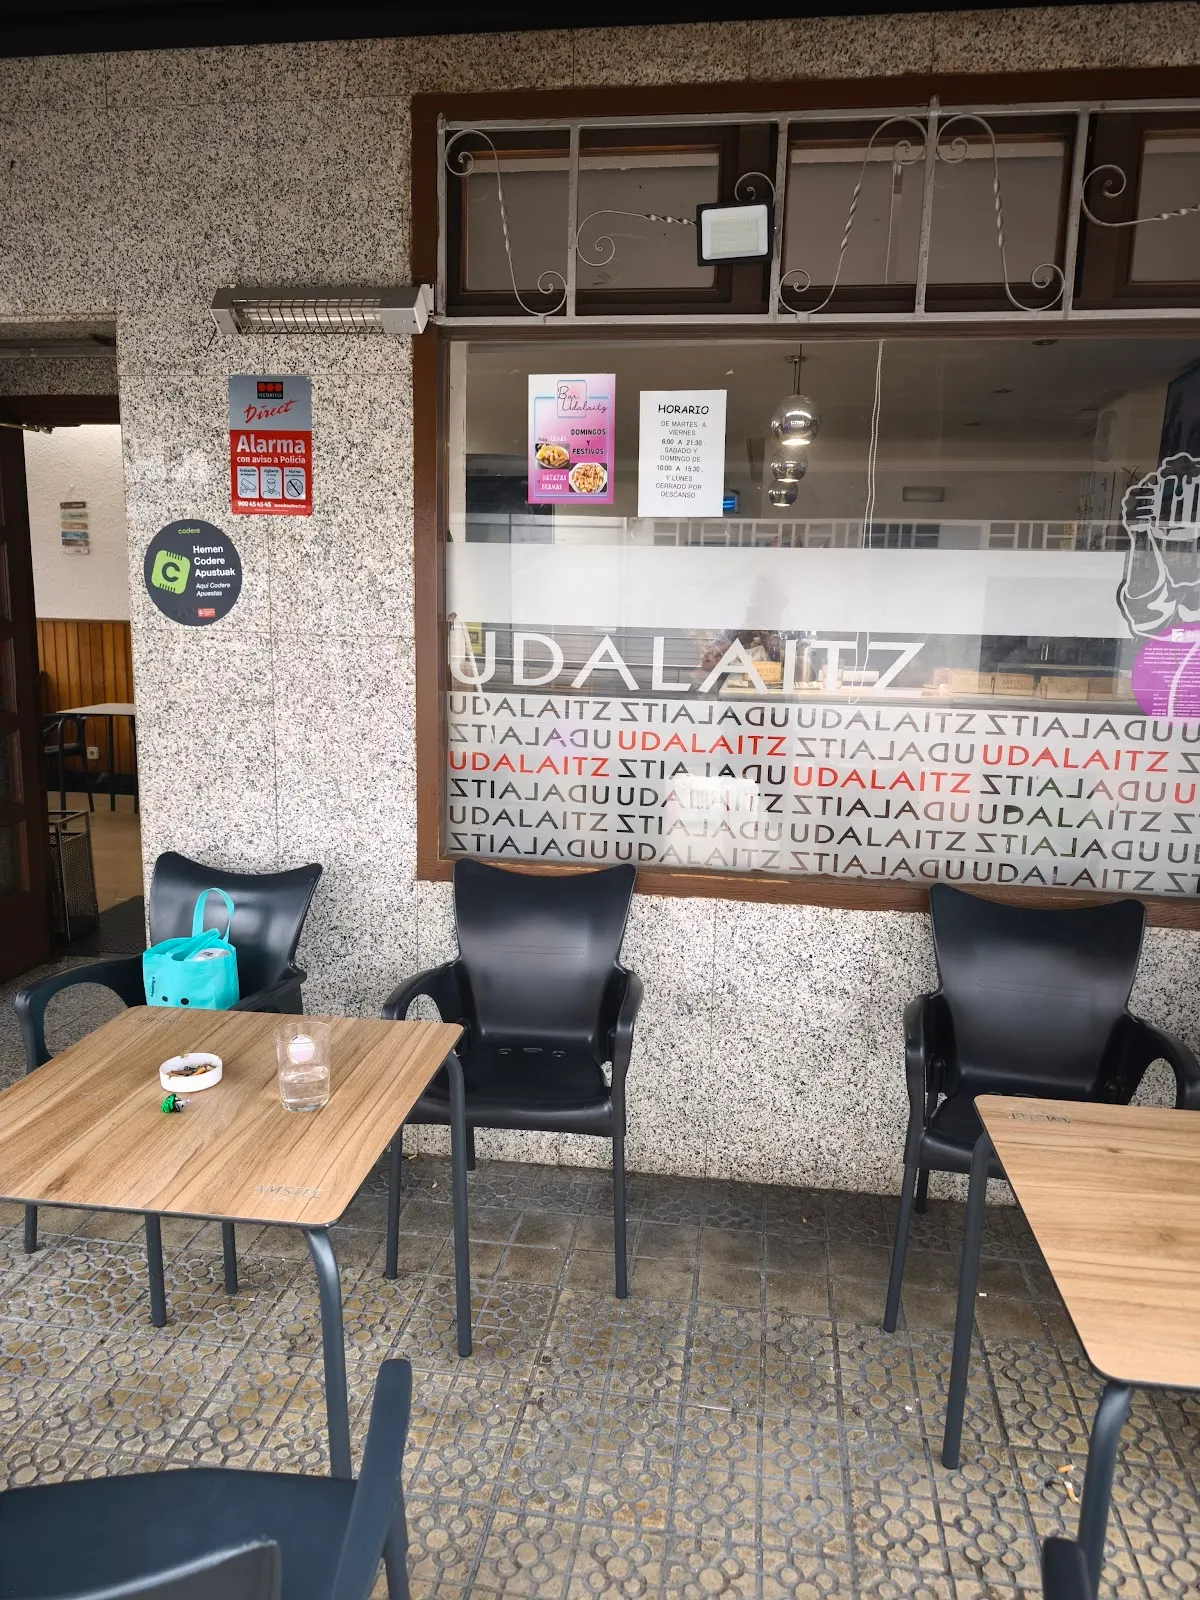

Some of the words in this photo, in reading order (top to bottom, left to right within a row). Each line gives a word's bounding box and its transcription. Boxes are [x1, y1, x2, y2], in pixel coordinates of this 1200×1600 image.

[557, 386, 579, 400] Bar
[244, 399, 300, 424] Direct
[562, 399, 608, 413] Udalaitz
[658, 404, 709, 414] HORARIO
[237, 434, 305, 454] Alarma
[252, 455, 272, 463] aviso
[193, 545, 223, 553] Hemen
[194, 557, 225, 565] Codere
[195, 568, 235, 578] Apustuak
[448, 630, 925, 698] UDALAITZ
[450, 695, 612, 721] UDALAITZ
[797, 707, 976, 734] UDALAITZ
[618, 730, 787, 757] UDALAITZ
[982, 744, 1169, 773] UDALAITZ
[450, 751, 610, 777] UDALAITZ
[793, 765, 971, 794] UDALAITZ
[450, 806, 608, 832] UDALAITZ
[790, 823, 966, 852] UDALAITZ
[978, 803, 1162, 834] UDALAITZ
[615, 841, 781, 870] UDALAITZ
[973, 862, 1156, 892] UDALAITZ
